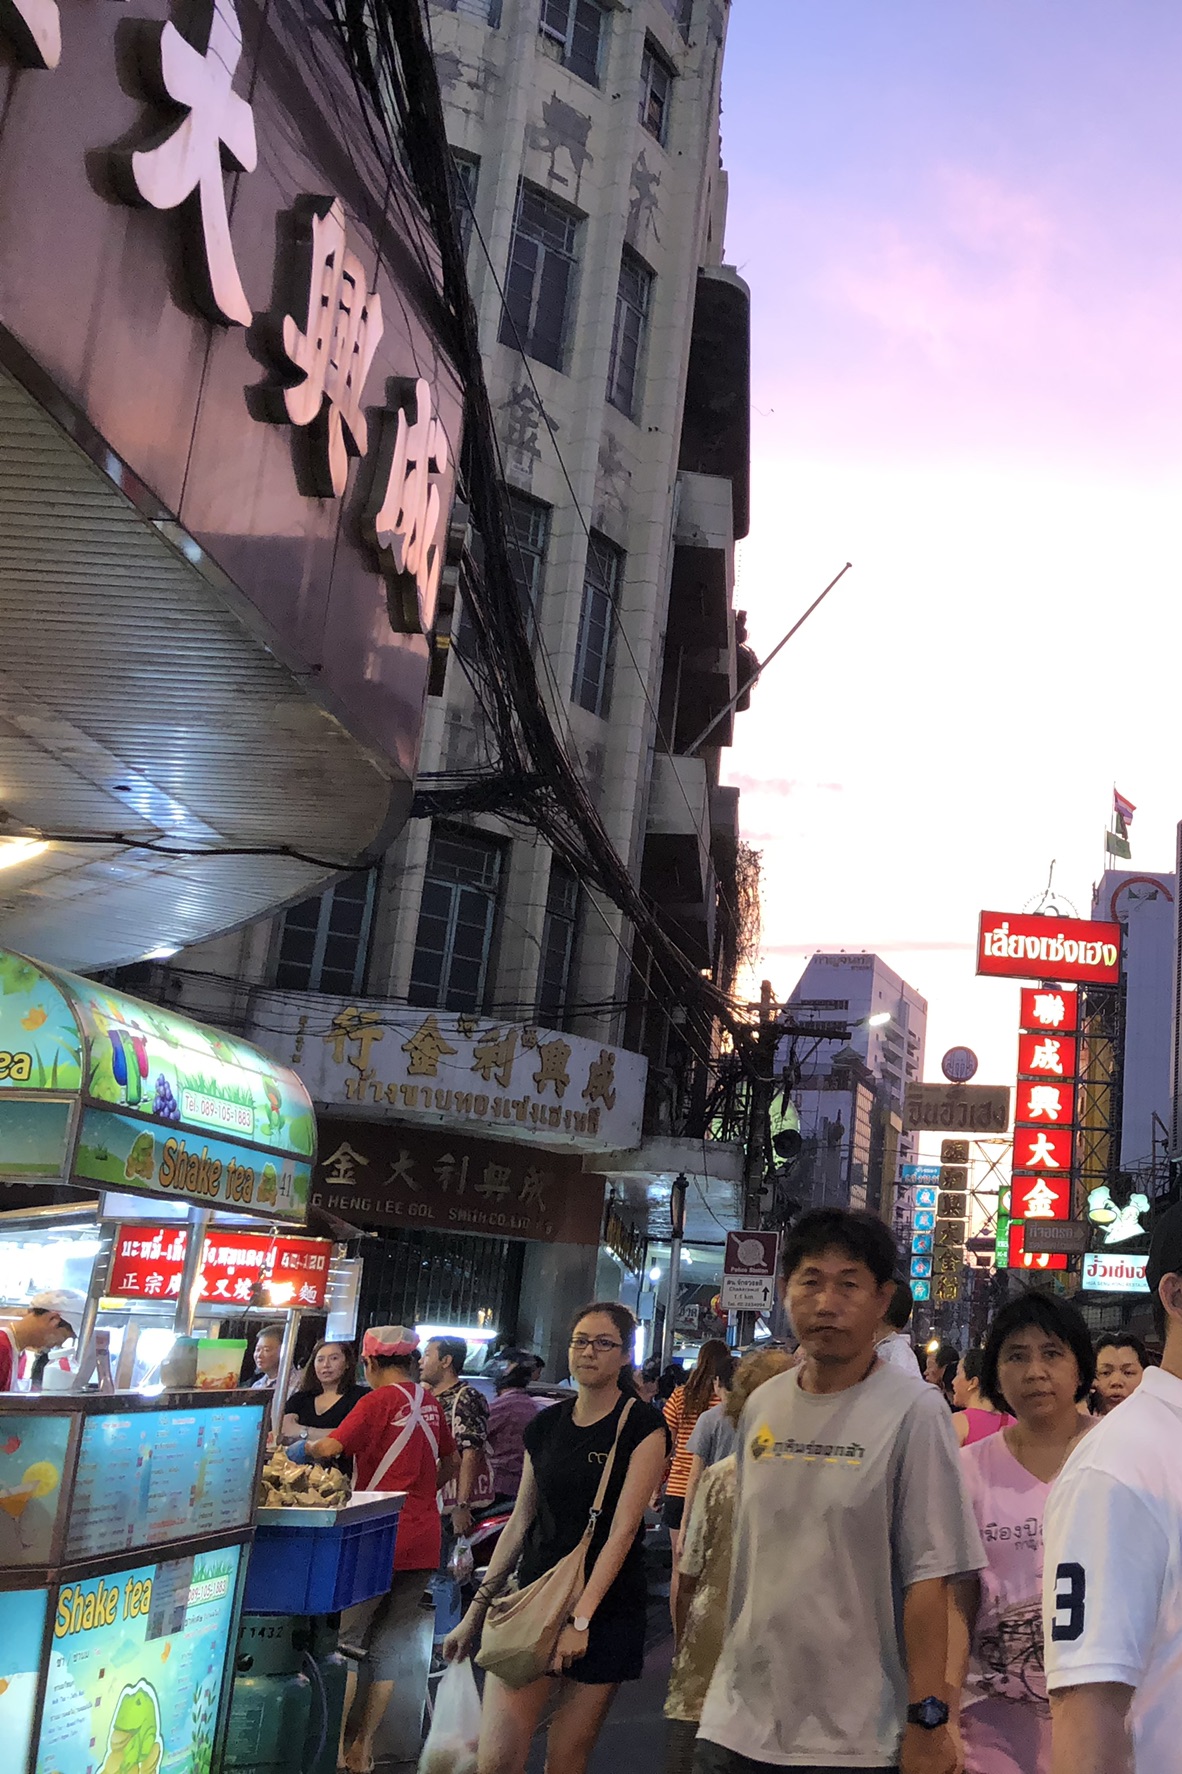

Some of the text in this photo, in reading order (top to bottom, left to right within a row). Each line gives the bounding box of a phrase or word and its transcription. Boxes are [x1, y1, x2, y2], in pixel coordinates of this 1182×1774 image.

[200, 1099, 252, 1128] 089-105-1883
[159, 1137, 221, 1198] Shake
[227, 1158, 255, 1203] tea
[328, 1194, 372, 1212] HENG
[375, 1199, 404, 1216] LEE
[55, 1576, 119, 1639] Shake
[121, 1574, 153, 1624] tea
[1052, 1562, 1085, 1642] 3
